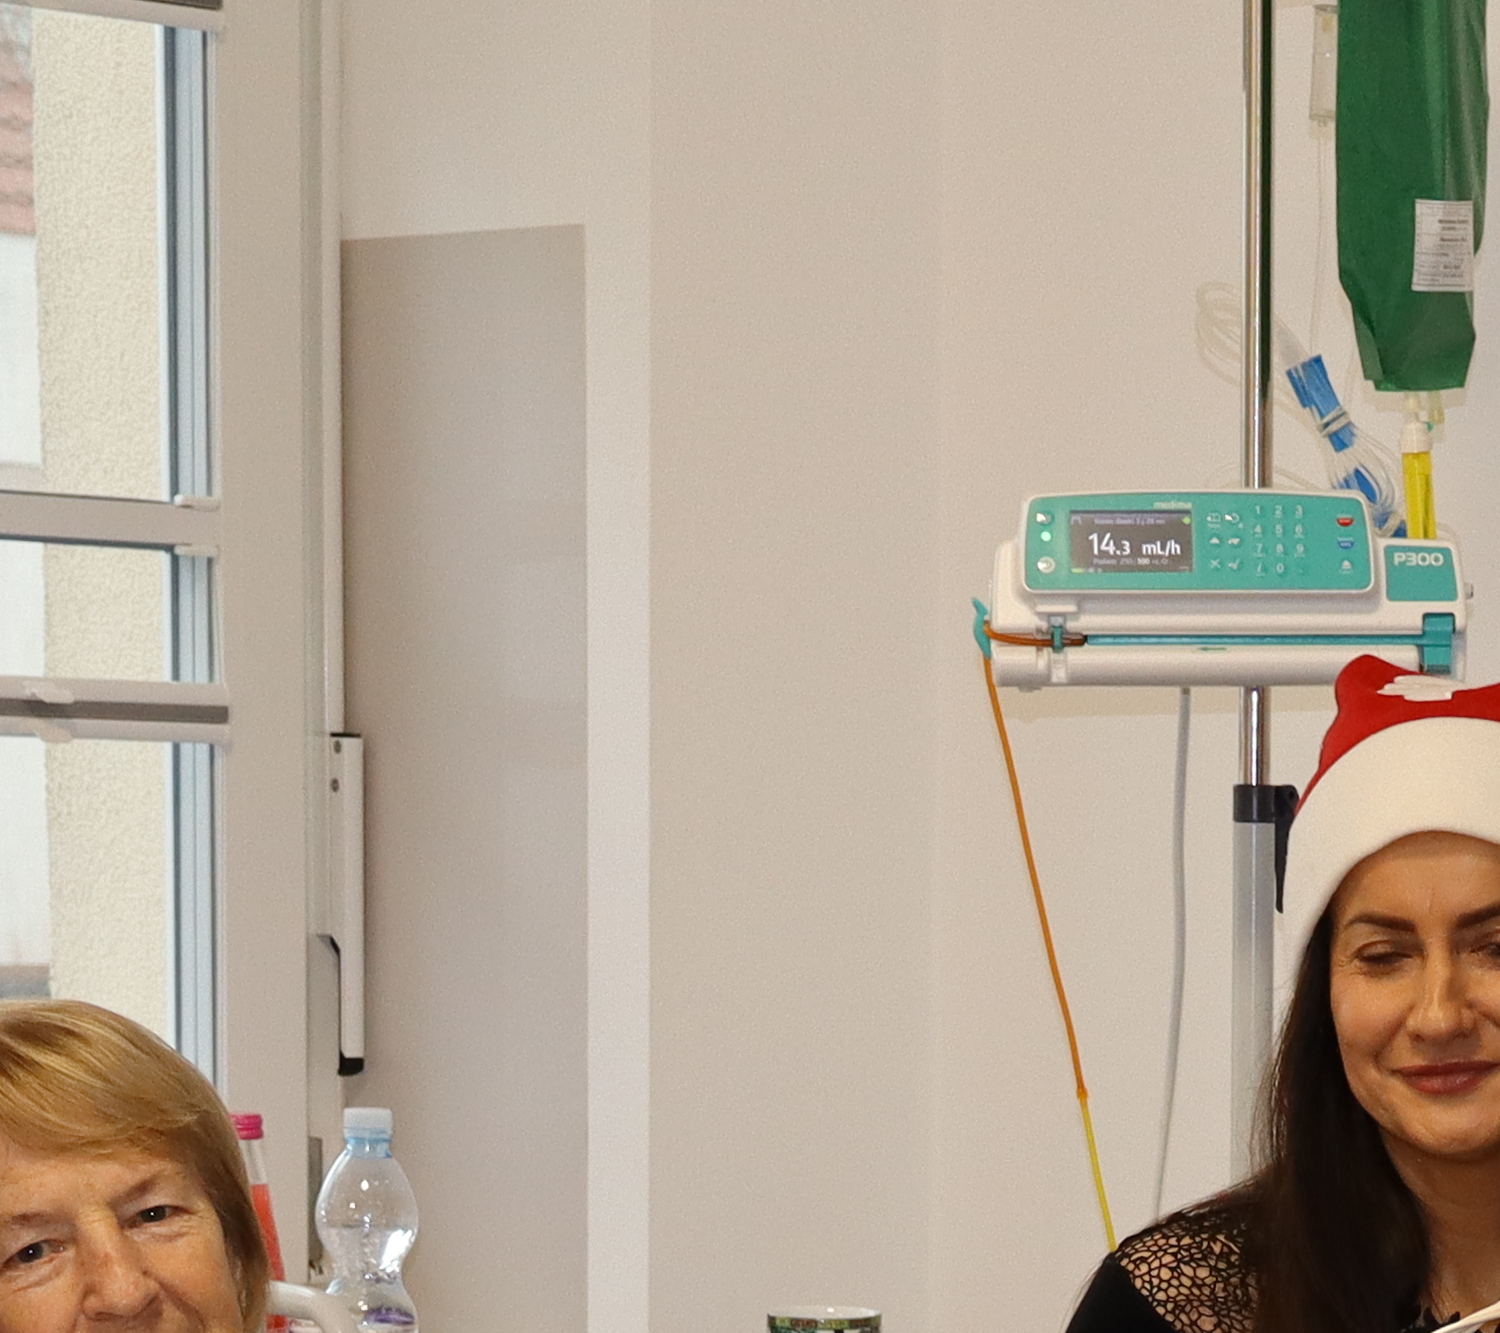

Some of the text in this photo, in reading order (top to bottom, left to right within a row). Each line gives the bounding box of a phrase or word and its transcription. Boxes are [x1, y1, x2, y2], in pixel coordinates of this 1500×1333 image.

[1088, 532, 1182, 557] 14.3 mL/h
[1393, 551, 1444, 567] P300
